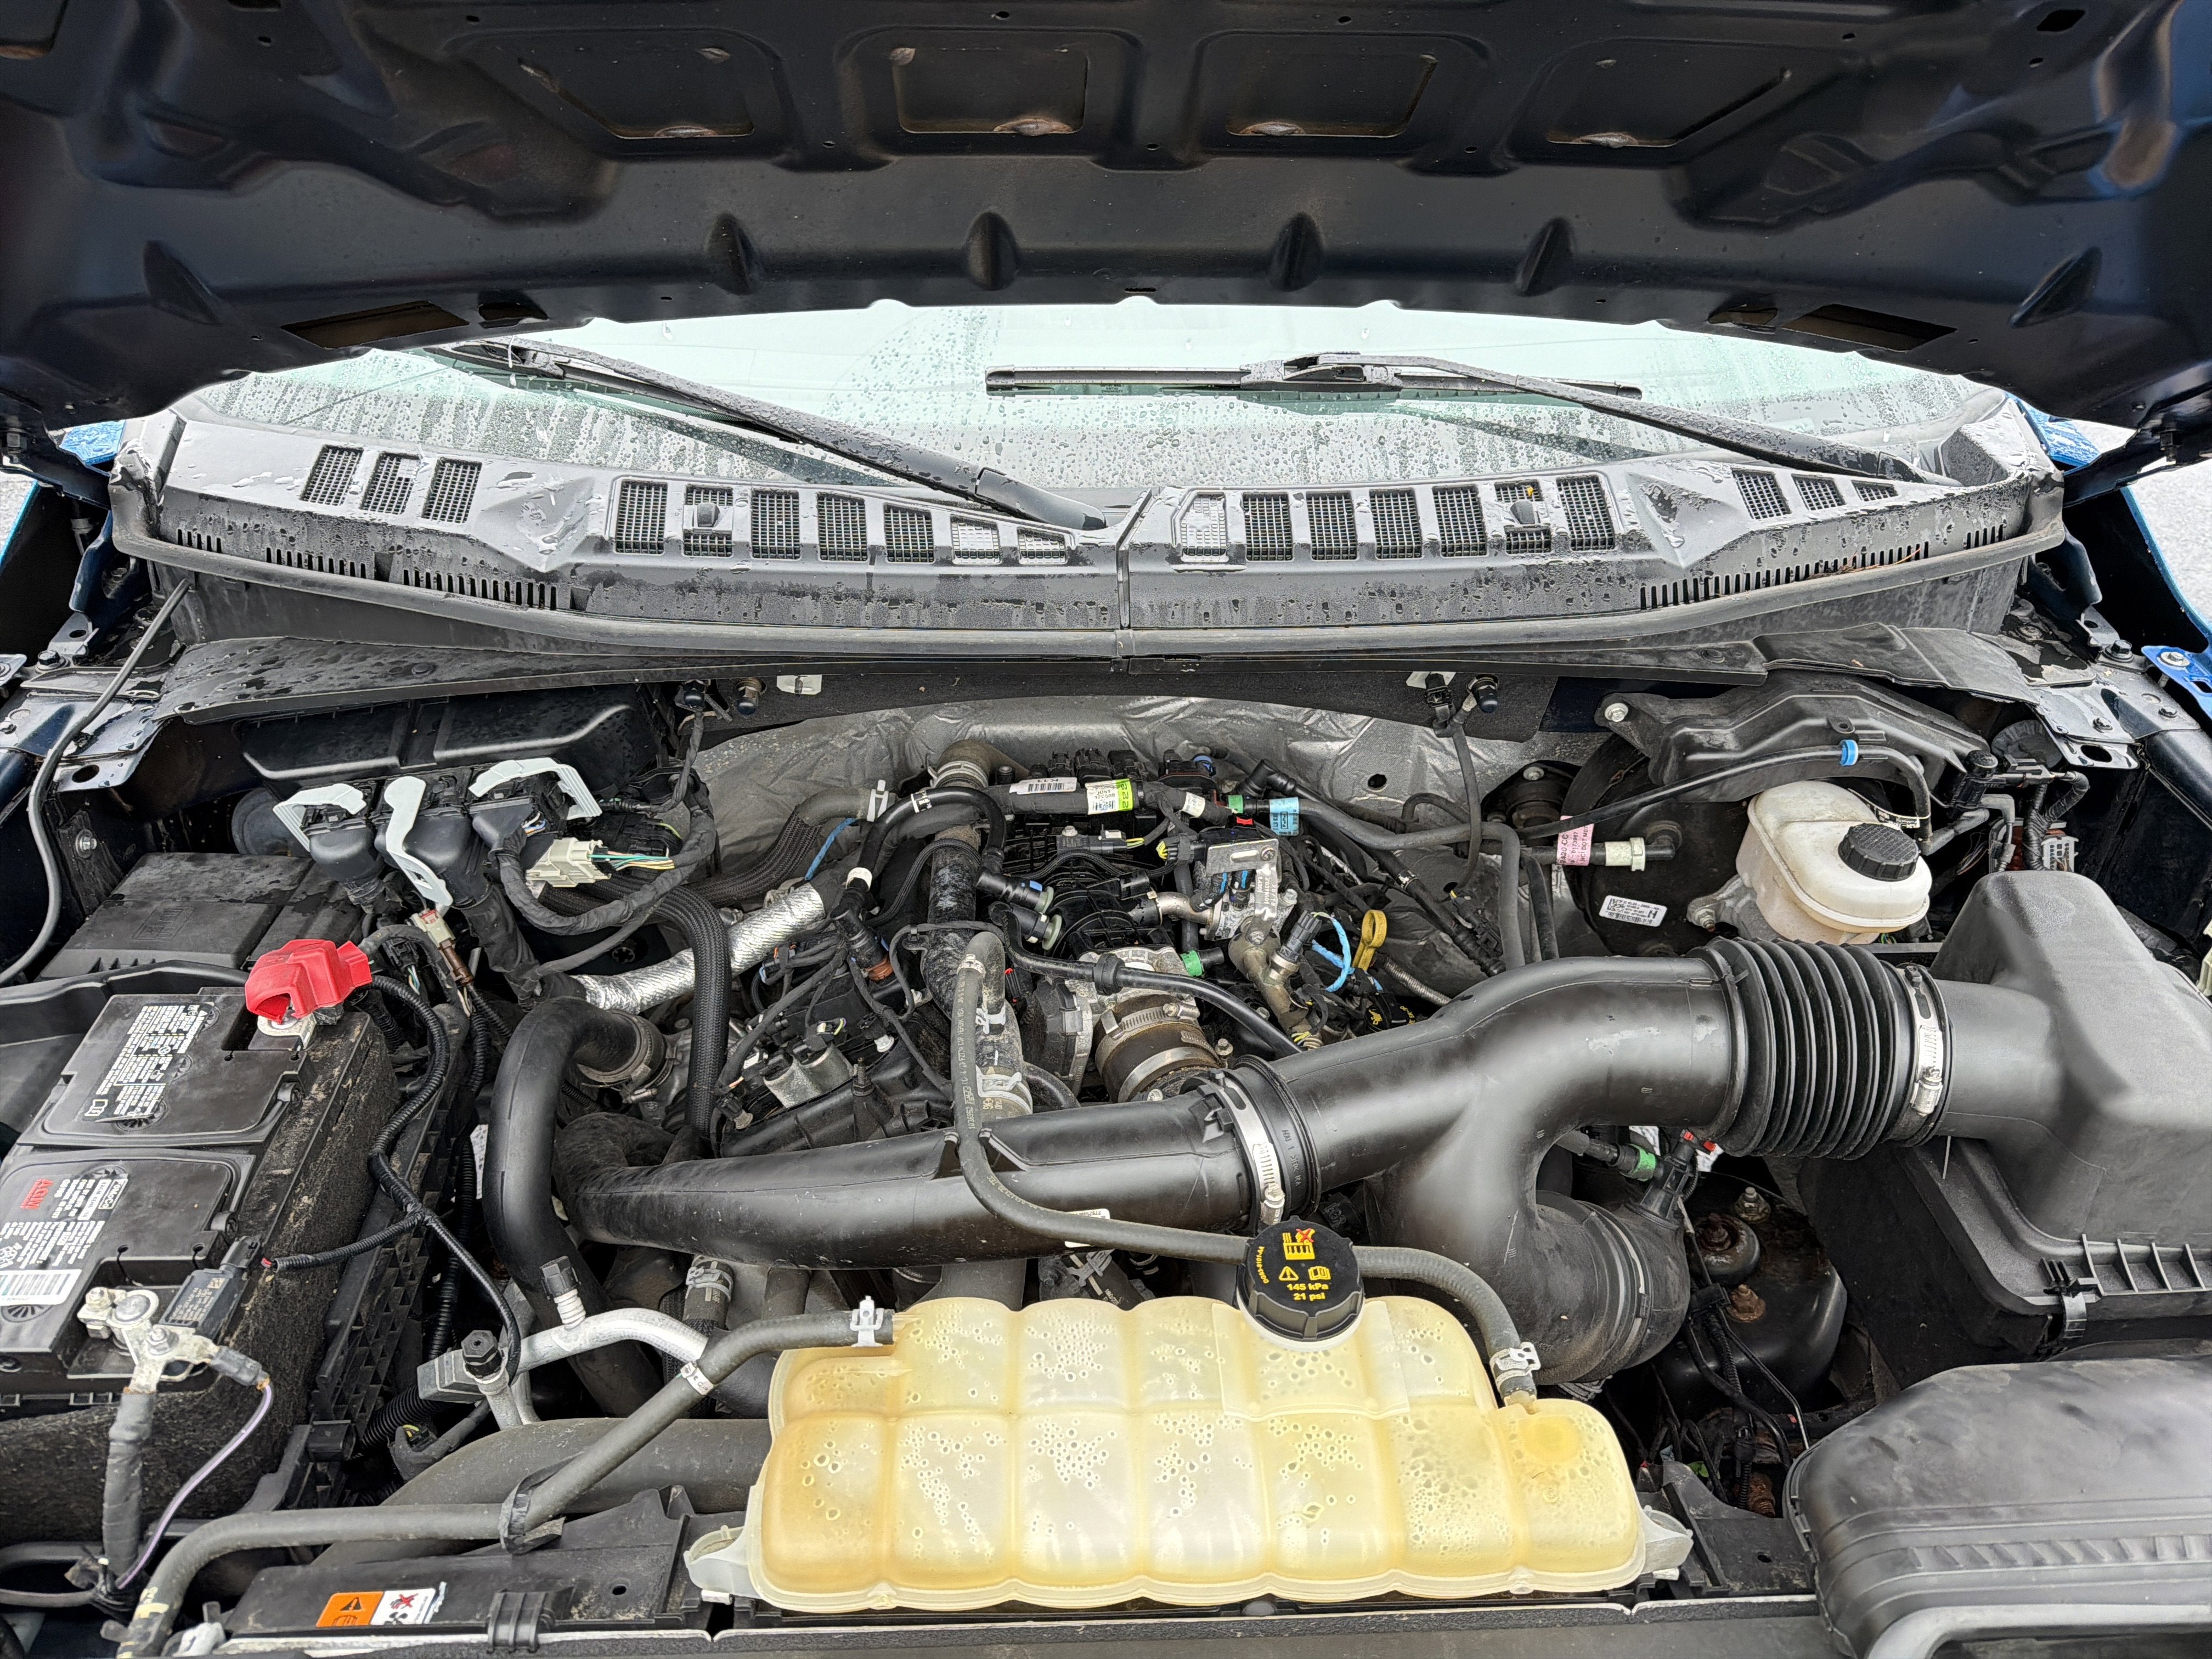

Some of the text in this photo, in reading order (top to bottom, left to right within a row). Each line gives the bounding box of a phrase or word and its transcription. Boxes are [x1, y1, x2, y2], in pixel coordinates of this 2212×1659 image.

[1647, 909, 1658, 919] H
[27, 1179, 53, 1209] AGM
[1287, 1283, 1329, 1291] 145 kPa
[1293, 1293, 1325, 1301] 21 psi
